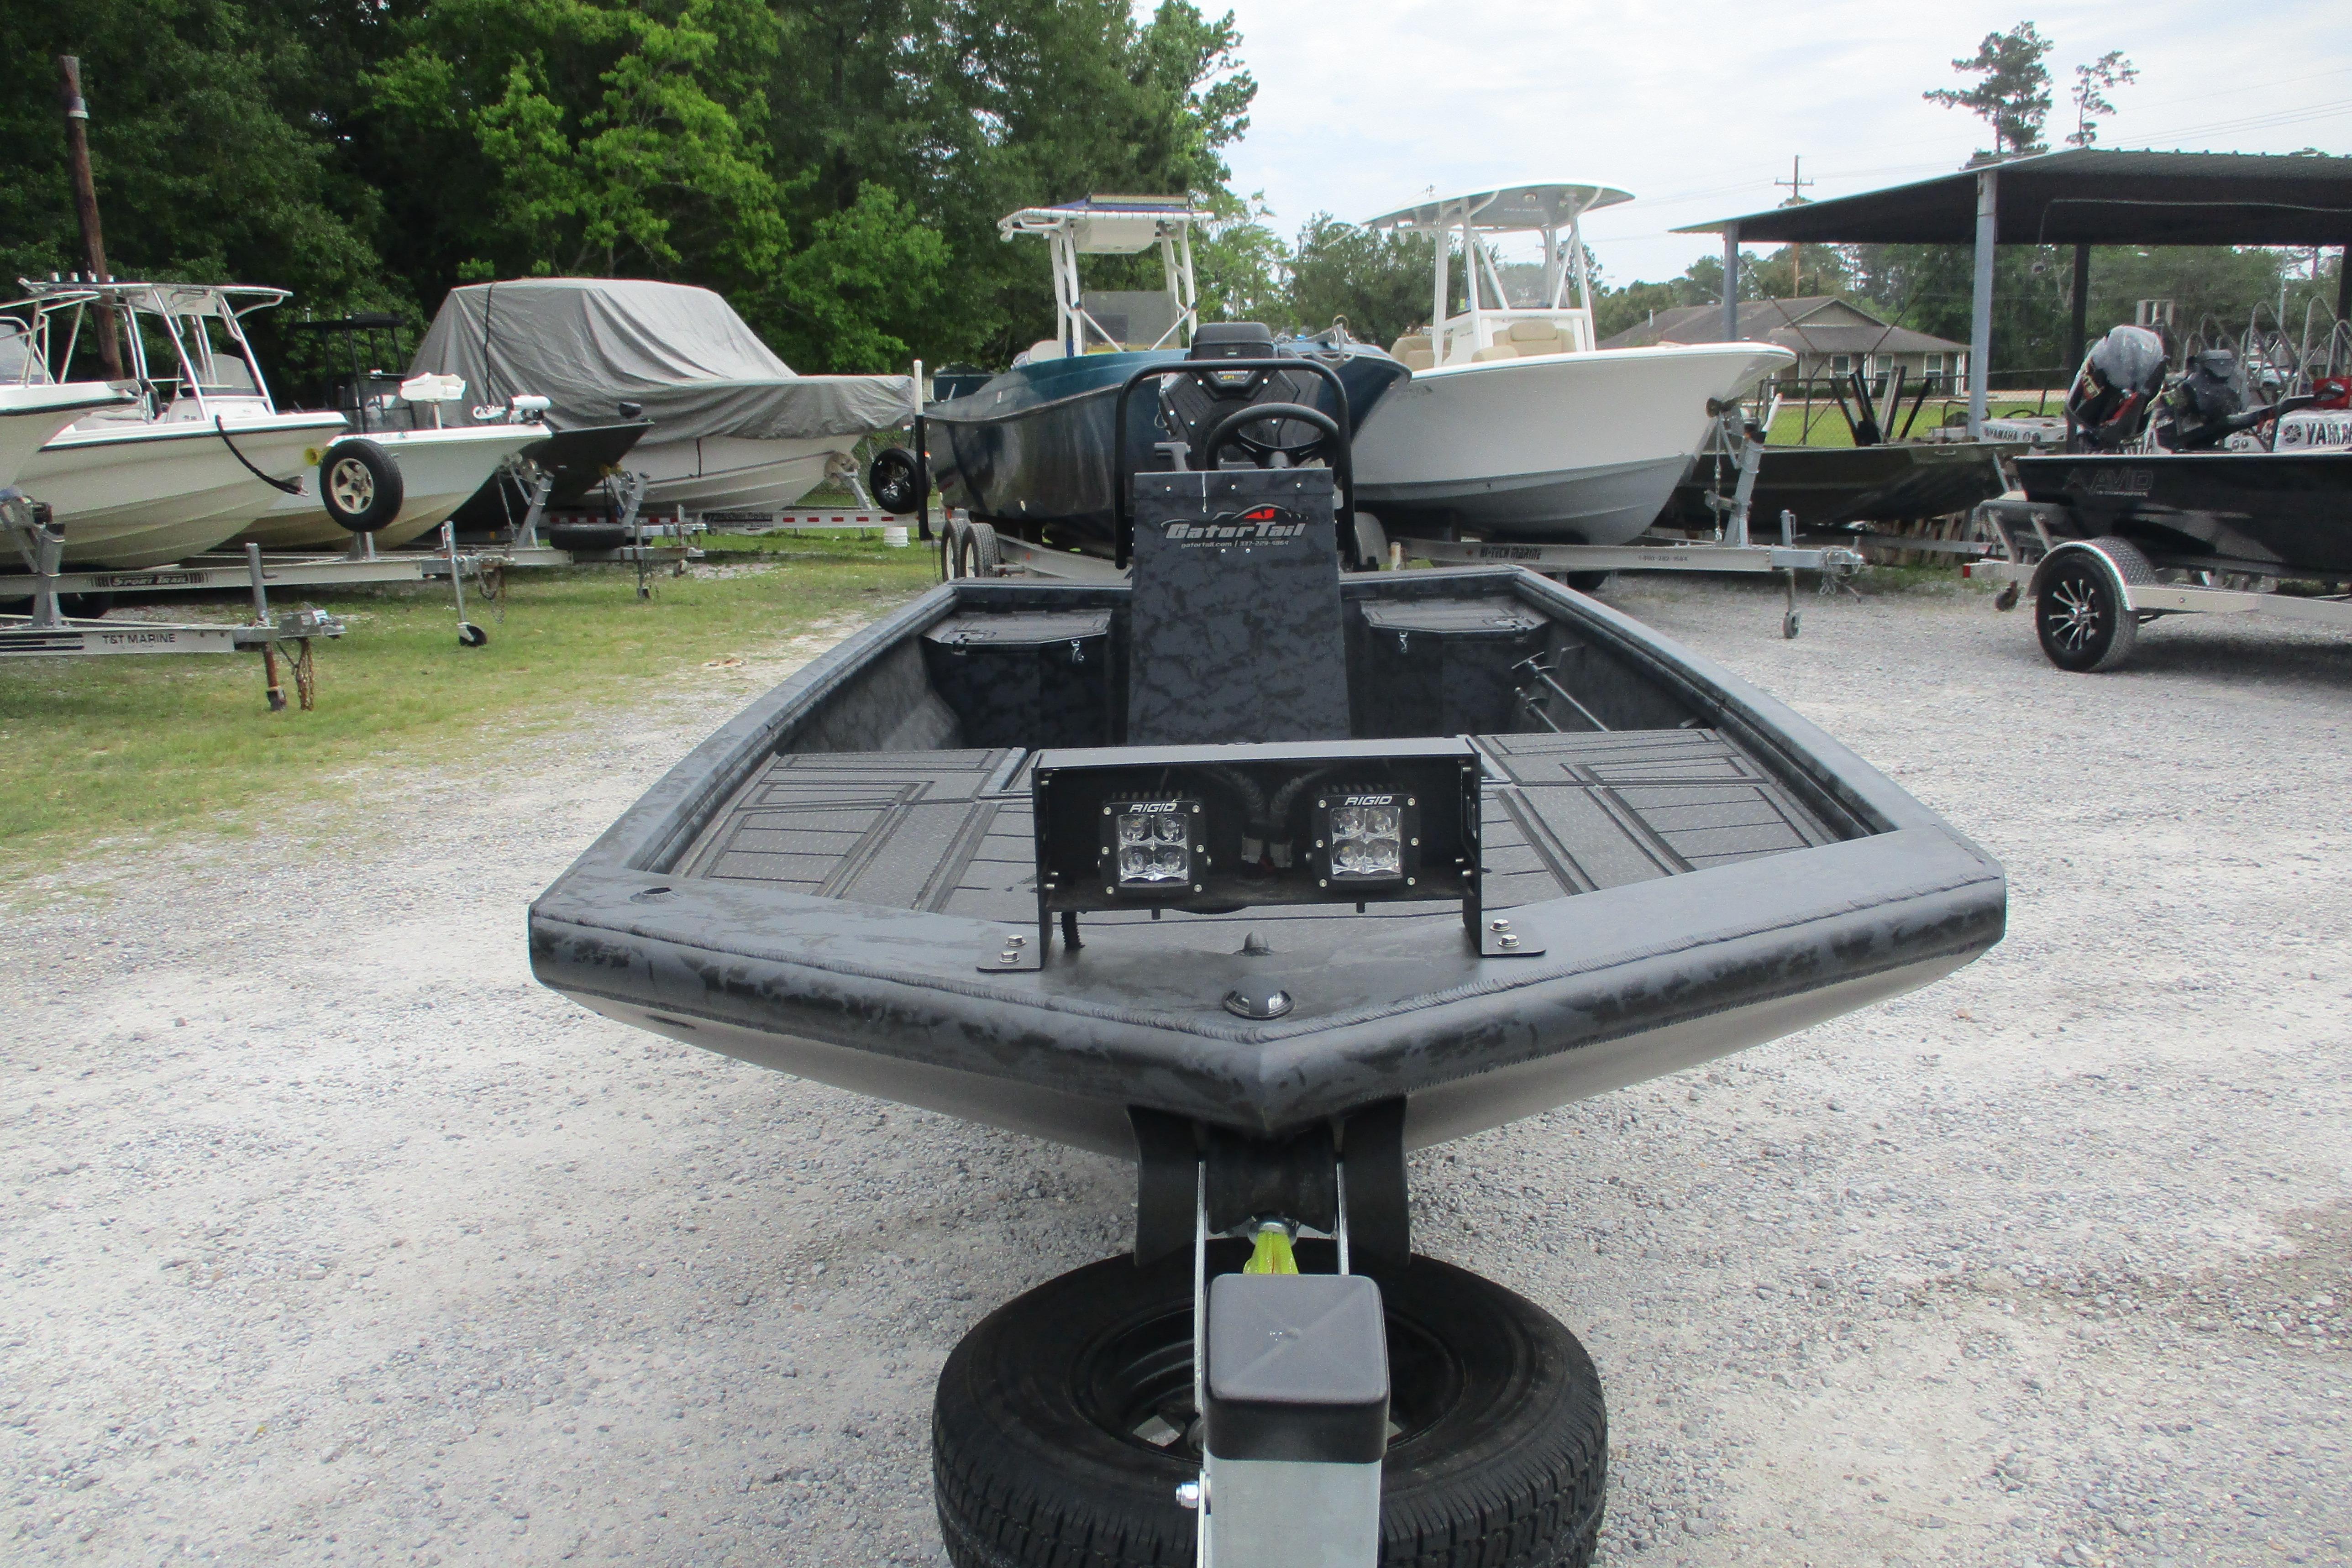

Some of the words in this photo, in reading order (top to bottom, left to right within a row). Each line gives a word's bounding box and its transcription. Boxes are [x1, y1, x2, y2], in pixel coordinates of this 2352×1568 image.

[1989, 428, 2018, 442] YAMAHA
[2088, 467, 2153, 493] AVID
[1166, 522, 1306, 539] GatorTail
[1480, 547, 1509, 558] HI-TECH
[102, 634, 124, 644] T&T
[127, 634, 175, 644] MARINE
[1344, 796, 1393, 806] RIGID
[1129, 803, 1177, 813] RIGID
